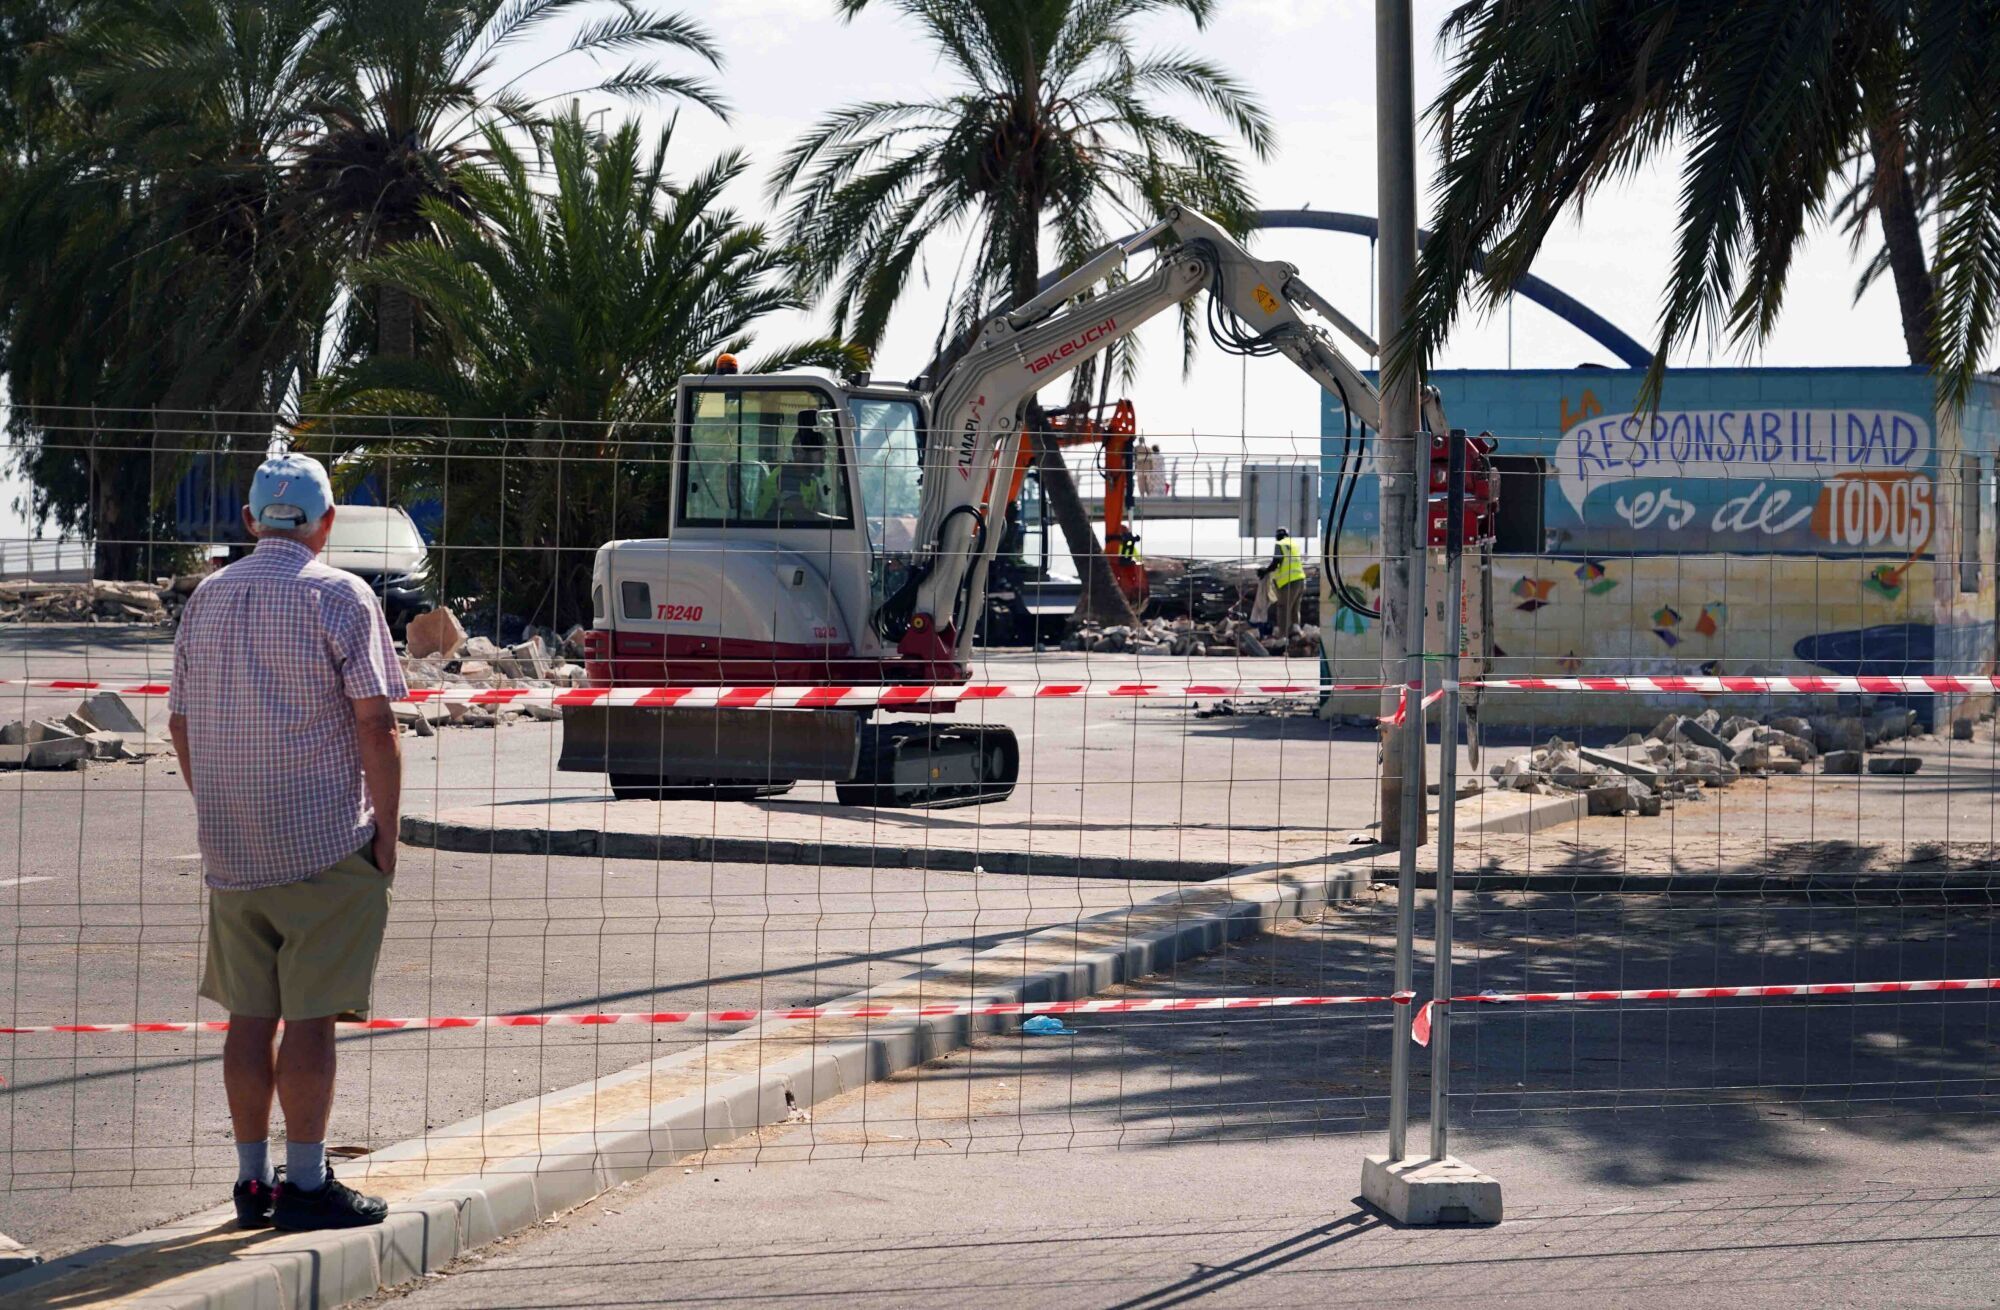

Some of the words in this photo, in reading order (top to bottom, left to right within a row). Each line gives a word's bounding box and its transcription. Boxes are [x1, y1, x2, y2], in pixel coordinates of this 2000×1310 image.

[1025, 318, 1117, 373] TAKEUCHI
[1561, 389, 1601, 432] LA
[1577, 411, 1918, 481] RESPONSABILIDAD
[1615, 487, 1695, 530] es
[1711, 482, 1813, 534] de
[1823, 475, 1931, 547] TODOS
[657, 604, 703, 622] TB240
